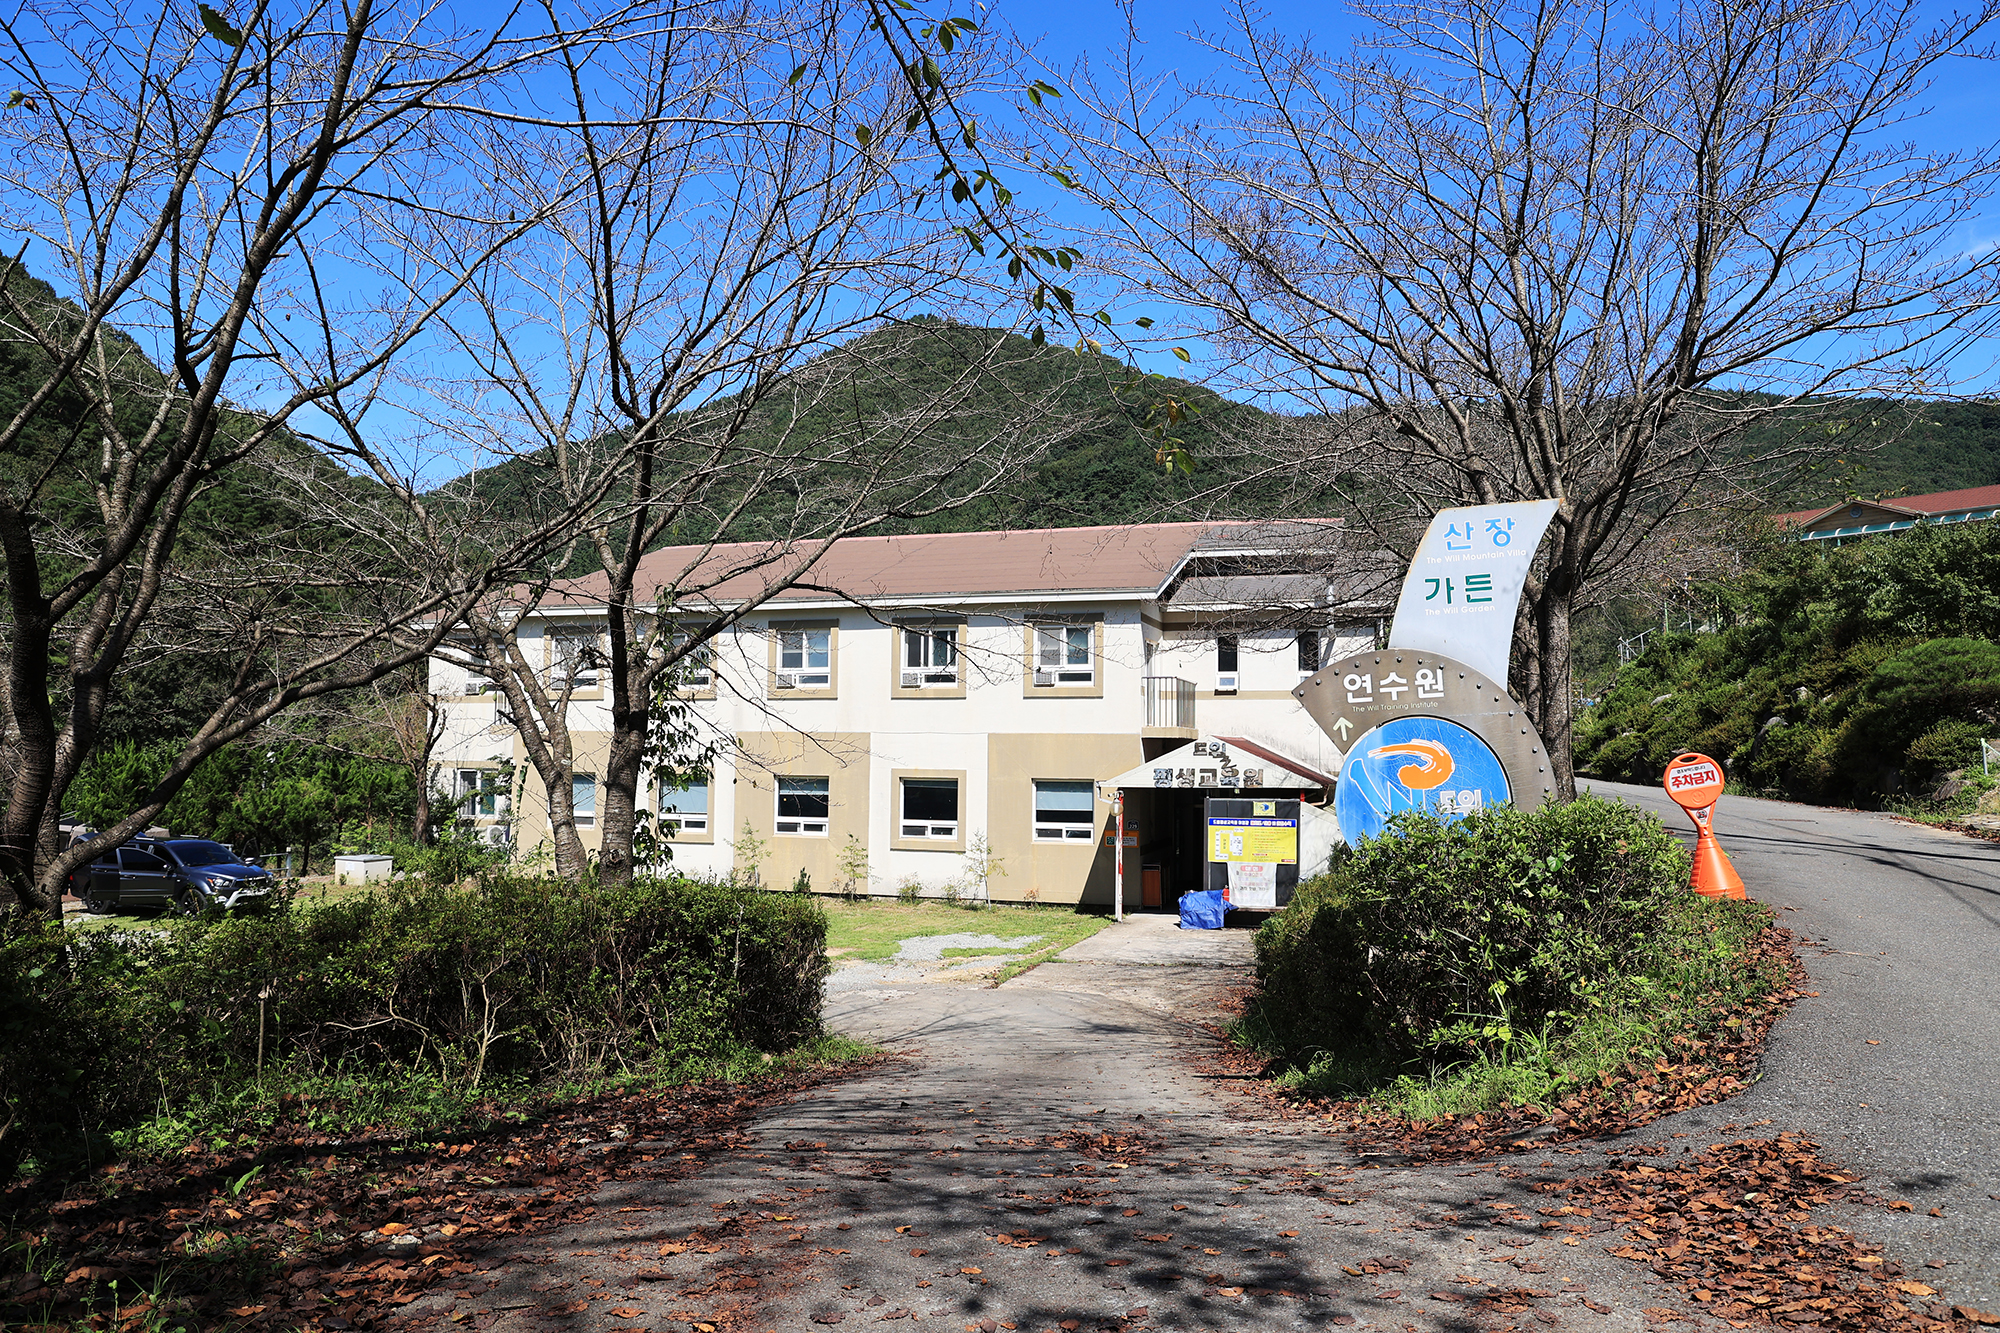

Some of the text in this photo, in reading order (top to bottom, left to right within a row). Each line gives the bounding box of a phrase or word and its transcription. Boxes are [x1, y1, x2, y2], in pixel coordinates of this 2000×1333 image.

[1443, 516, 1516, 551] 산장
[1426, 549, 1527, 564] The Will Mountain Villa
[1424, 573, 1493, 605] 가든
[1425, 605, 1496, 616] The Will Garden
[1343, 668, 1445, 704] 연수원
[1381, 703, 1409, 711] Training
[1410, 701, 1438, 709] Institute
[1153, 767, 1263, 788] 평생교육원
[1671, 770, 1716, 788] 주차금지
